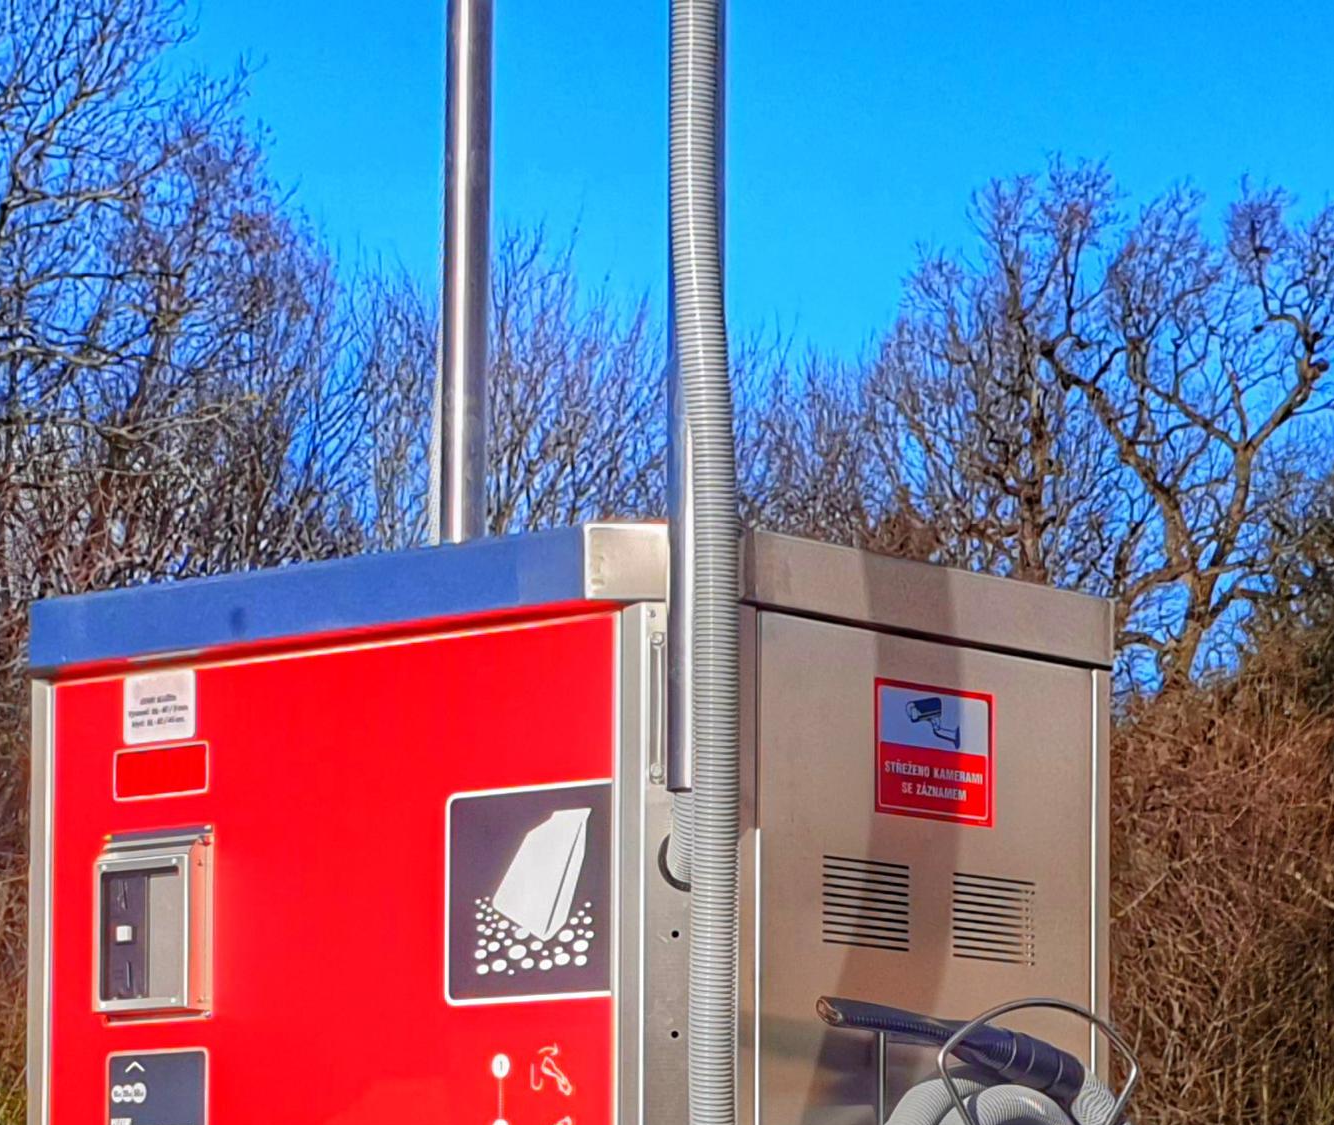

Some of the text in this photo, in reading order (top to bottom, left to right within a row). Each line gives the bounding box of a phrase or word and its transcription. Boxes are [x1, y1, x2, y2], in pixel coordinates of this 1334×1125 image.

[884, 759, 984, 785] STŘEŽENO KAMERAMI
[901, 782, 967, 802] SE ZÁZNAMEM
